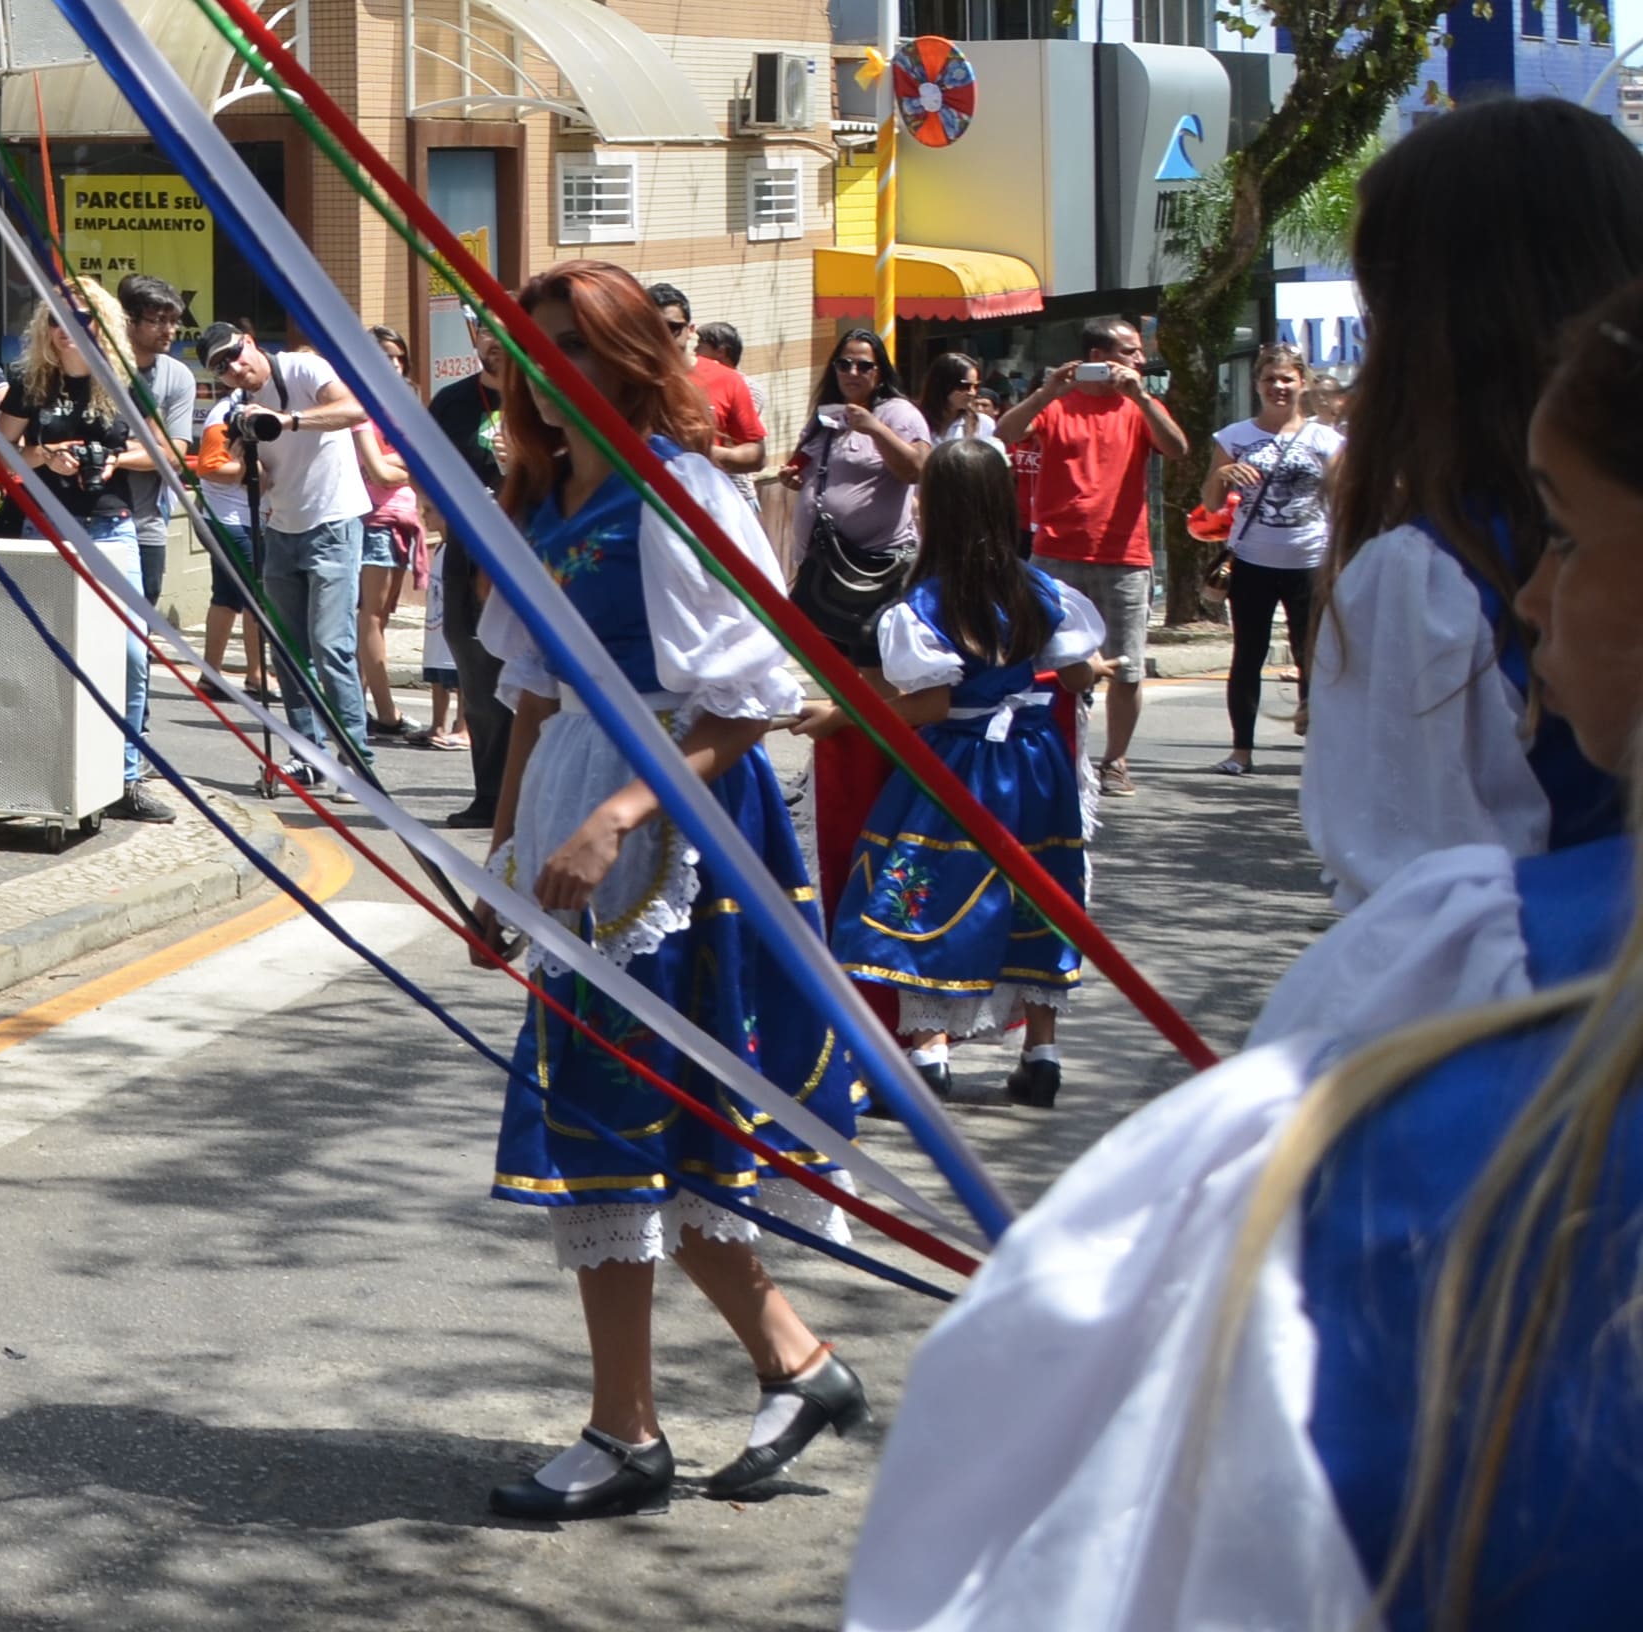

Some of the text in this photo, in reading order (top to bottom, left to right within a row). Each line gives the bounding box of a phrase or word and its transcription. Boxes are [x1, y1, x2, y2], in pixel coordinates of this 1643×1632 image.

[76, 191, 205, 210] PARCELE SEU
[74, 217, 206, 232] EMPLACAMENTO
[80, 257, 103, 270] EM
